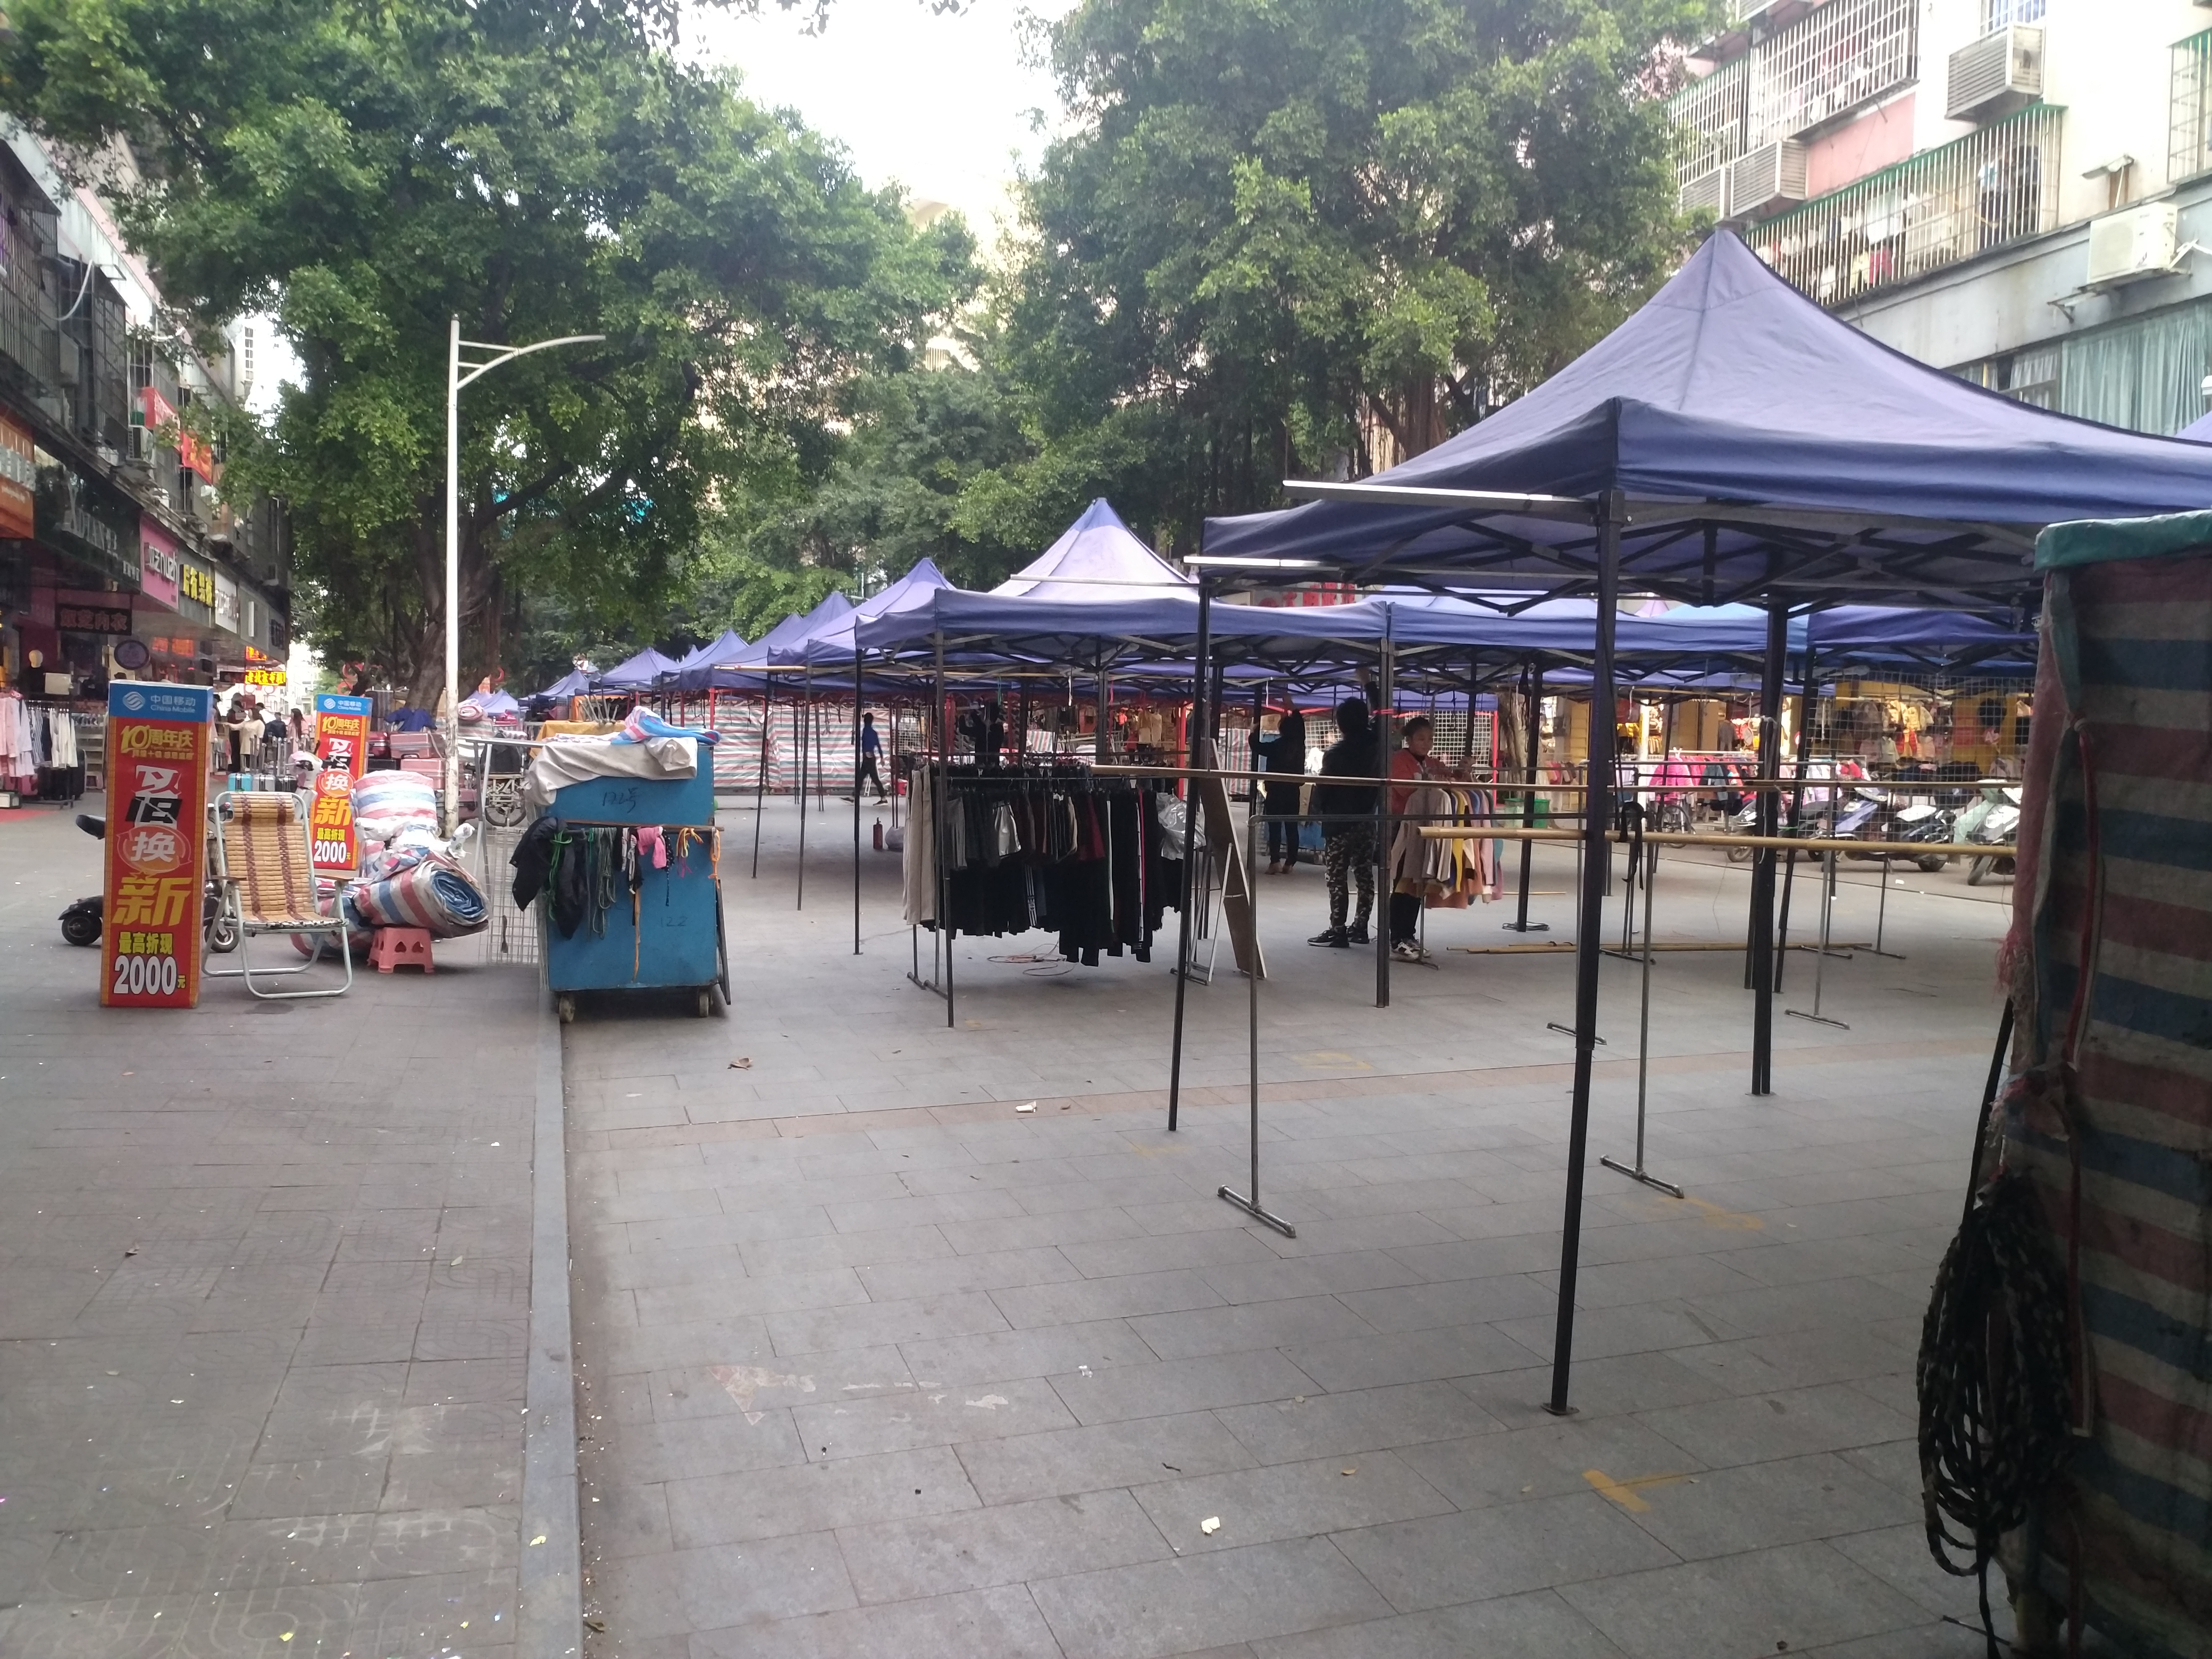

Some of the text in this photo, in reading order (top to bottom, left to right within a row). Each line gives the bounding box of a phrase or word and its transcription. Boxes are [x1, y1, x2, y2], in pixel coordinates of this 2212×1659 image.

[150, 694, 196, 707] 中国移动
[322, 716, 361, 732] 10周年庆
[115, 724, 194, 754] 10周年庆
[316, 827, 345, 842] 最高折现
[660, 916, 688, 928] 122
[119, 932, 173, 955] 最高折现
